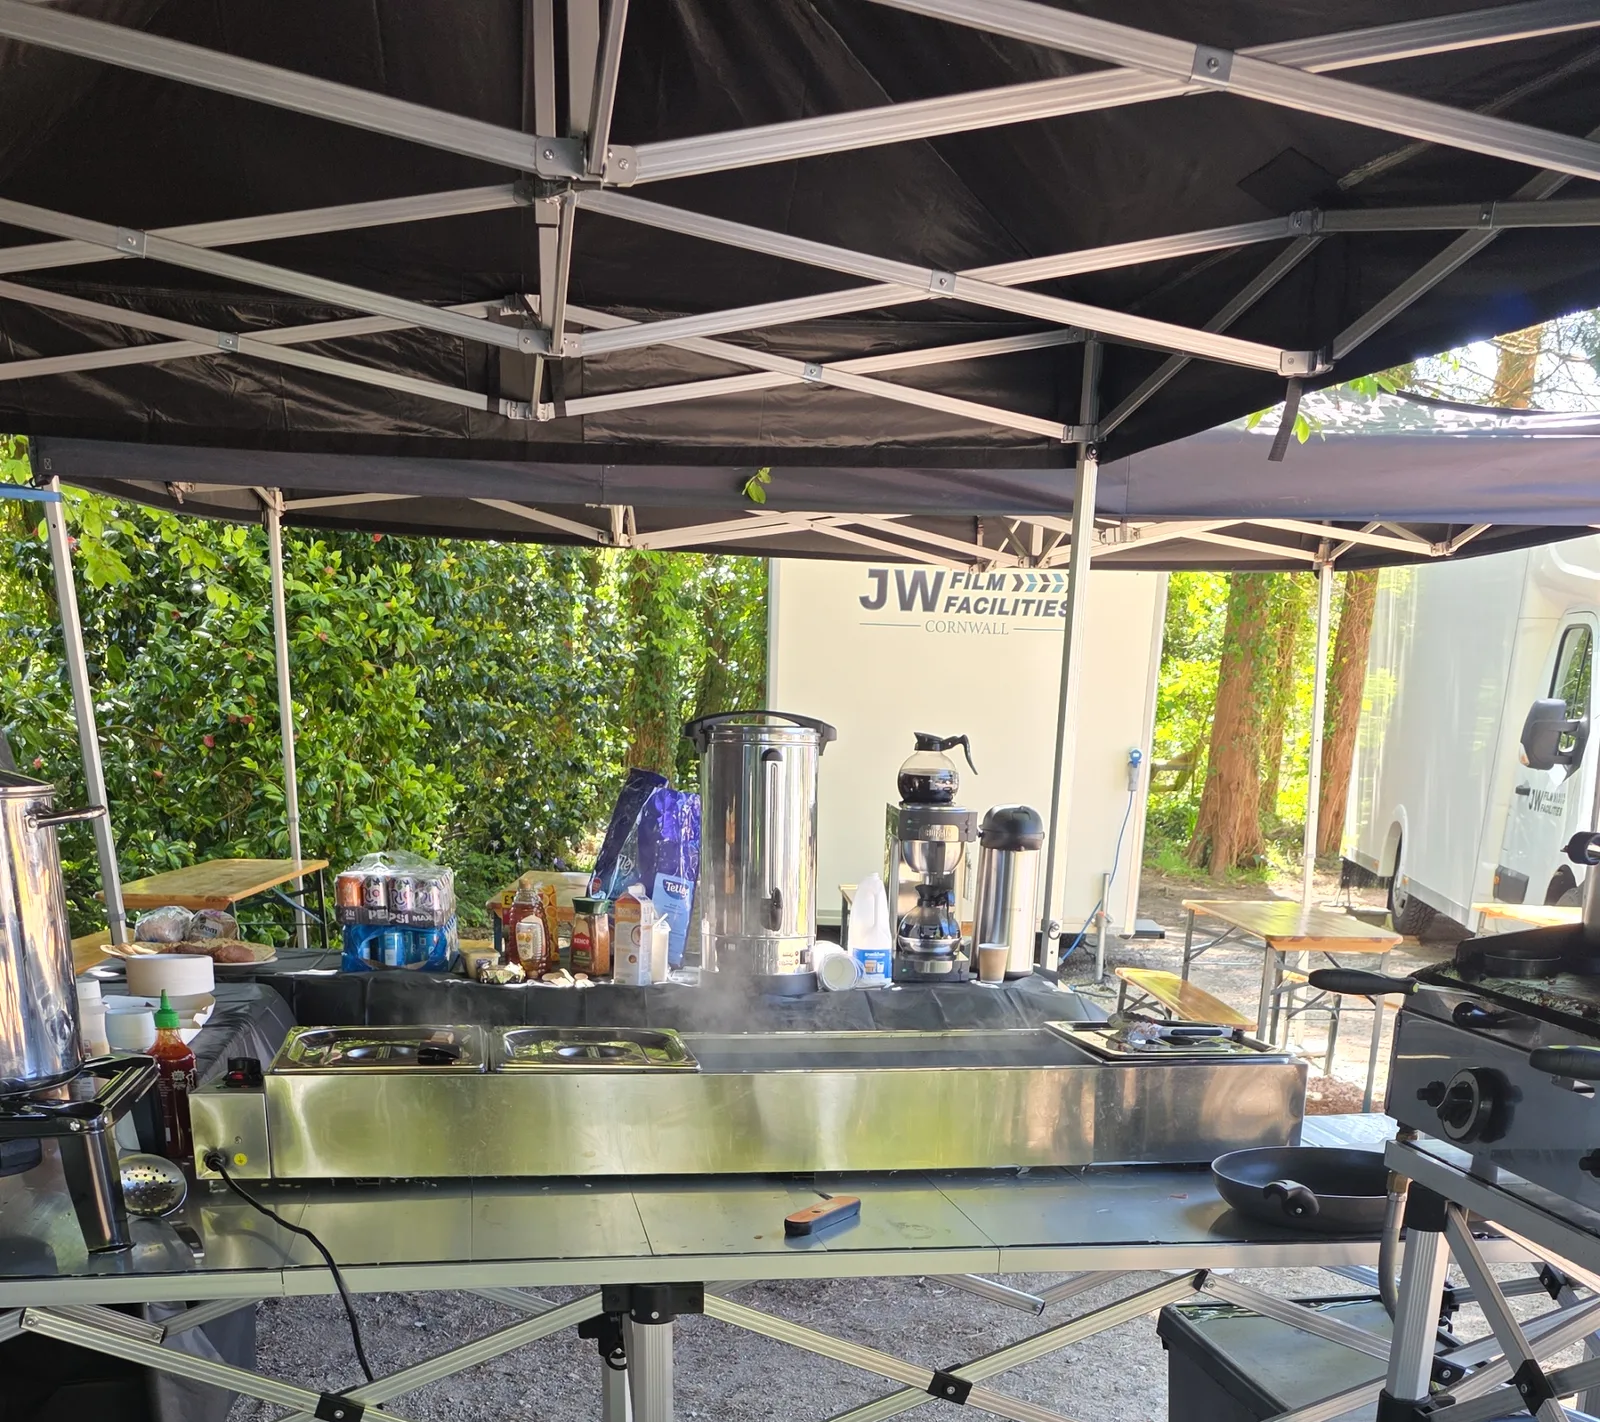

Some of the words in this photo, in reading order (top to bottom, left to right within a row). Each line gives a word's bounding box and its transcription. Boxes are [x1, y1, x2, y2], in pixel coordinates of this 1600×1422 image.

[858, 568, 945, 613] JW
[949, 572, 1007, 592] FILM
[943, 596, 1069, 618] FACILITIES
[925, 619, 1009, 635] CORNWALL
[368, 909, 409, 924] PEPSI
